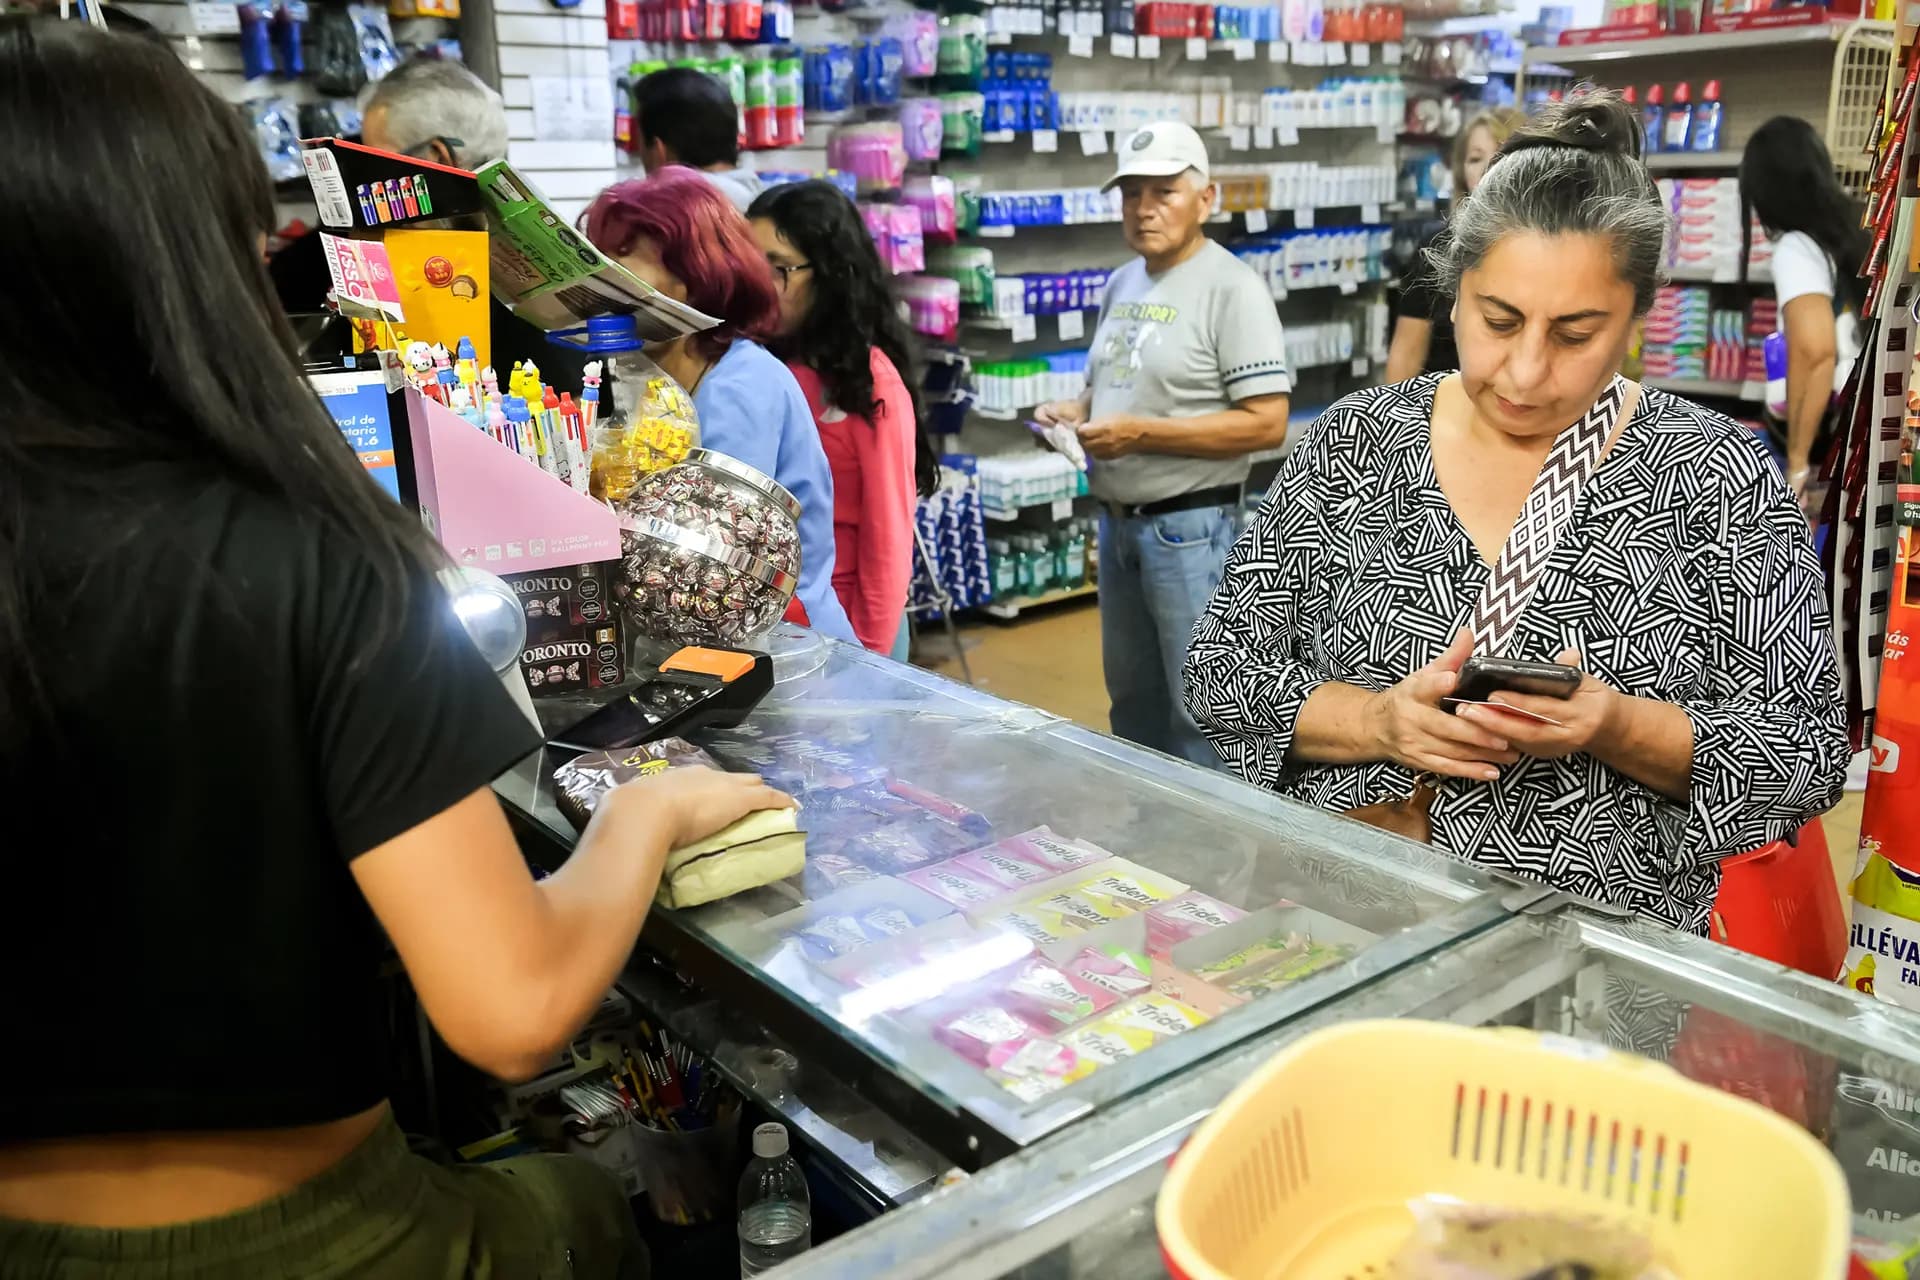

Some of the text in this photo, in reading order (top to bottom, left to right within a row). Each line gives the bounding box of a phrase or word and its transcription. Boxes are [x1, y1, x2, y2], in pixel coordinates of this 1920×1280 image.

[356, 435, 379, 447] 1.6
[513, 576, 572, 595] RONTO
[521, 642, 591, 664] ORONTO
[1028, 837, 1083, 863] Trident
[981, 854, 1036, 882] Trident
[1101, 877, 1160, 905] Trident
[1050, 894, 1112, 925] Trident
[1175, 901, 1229, 926] Triden
[1901, 967, 1920, 987] FA
[1137, 1004, 1187, 1032] Tride
